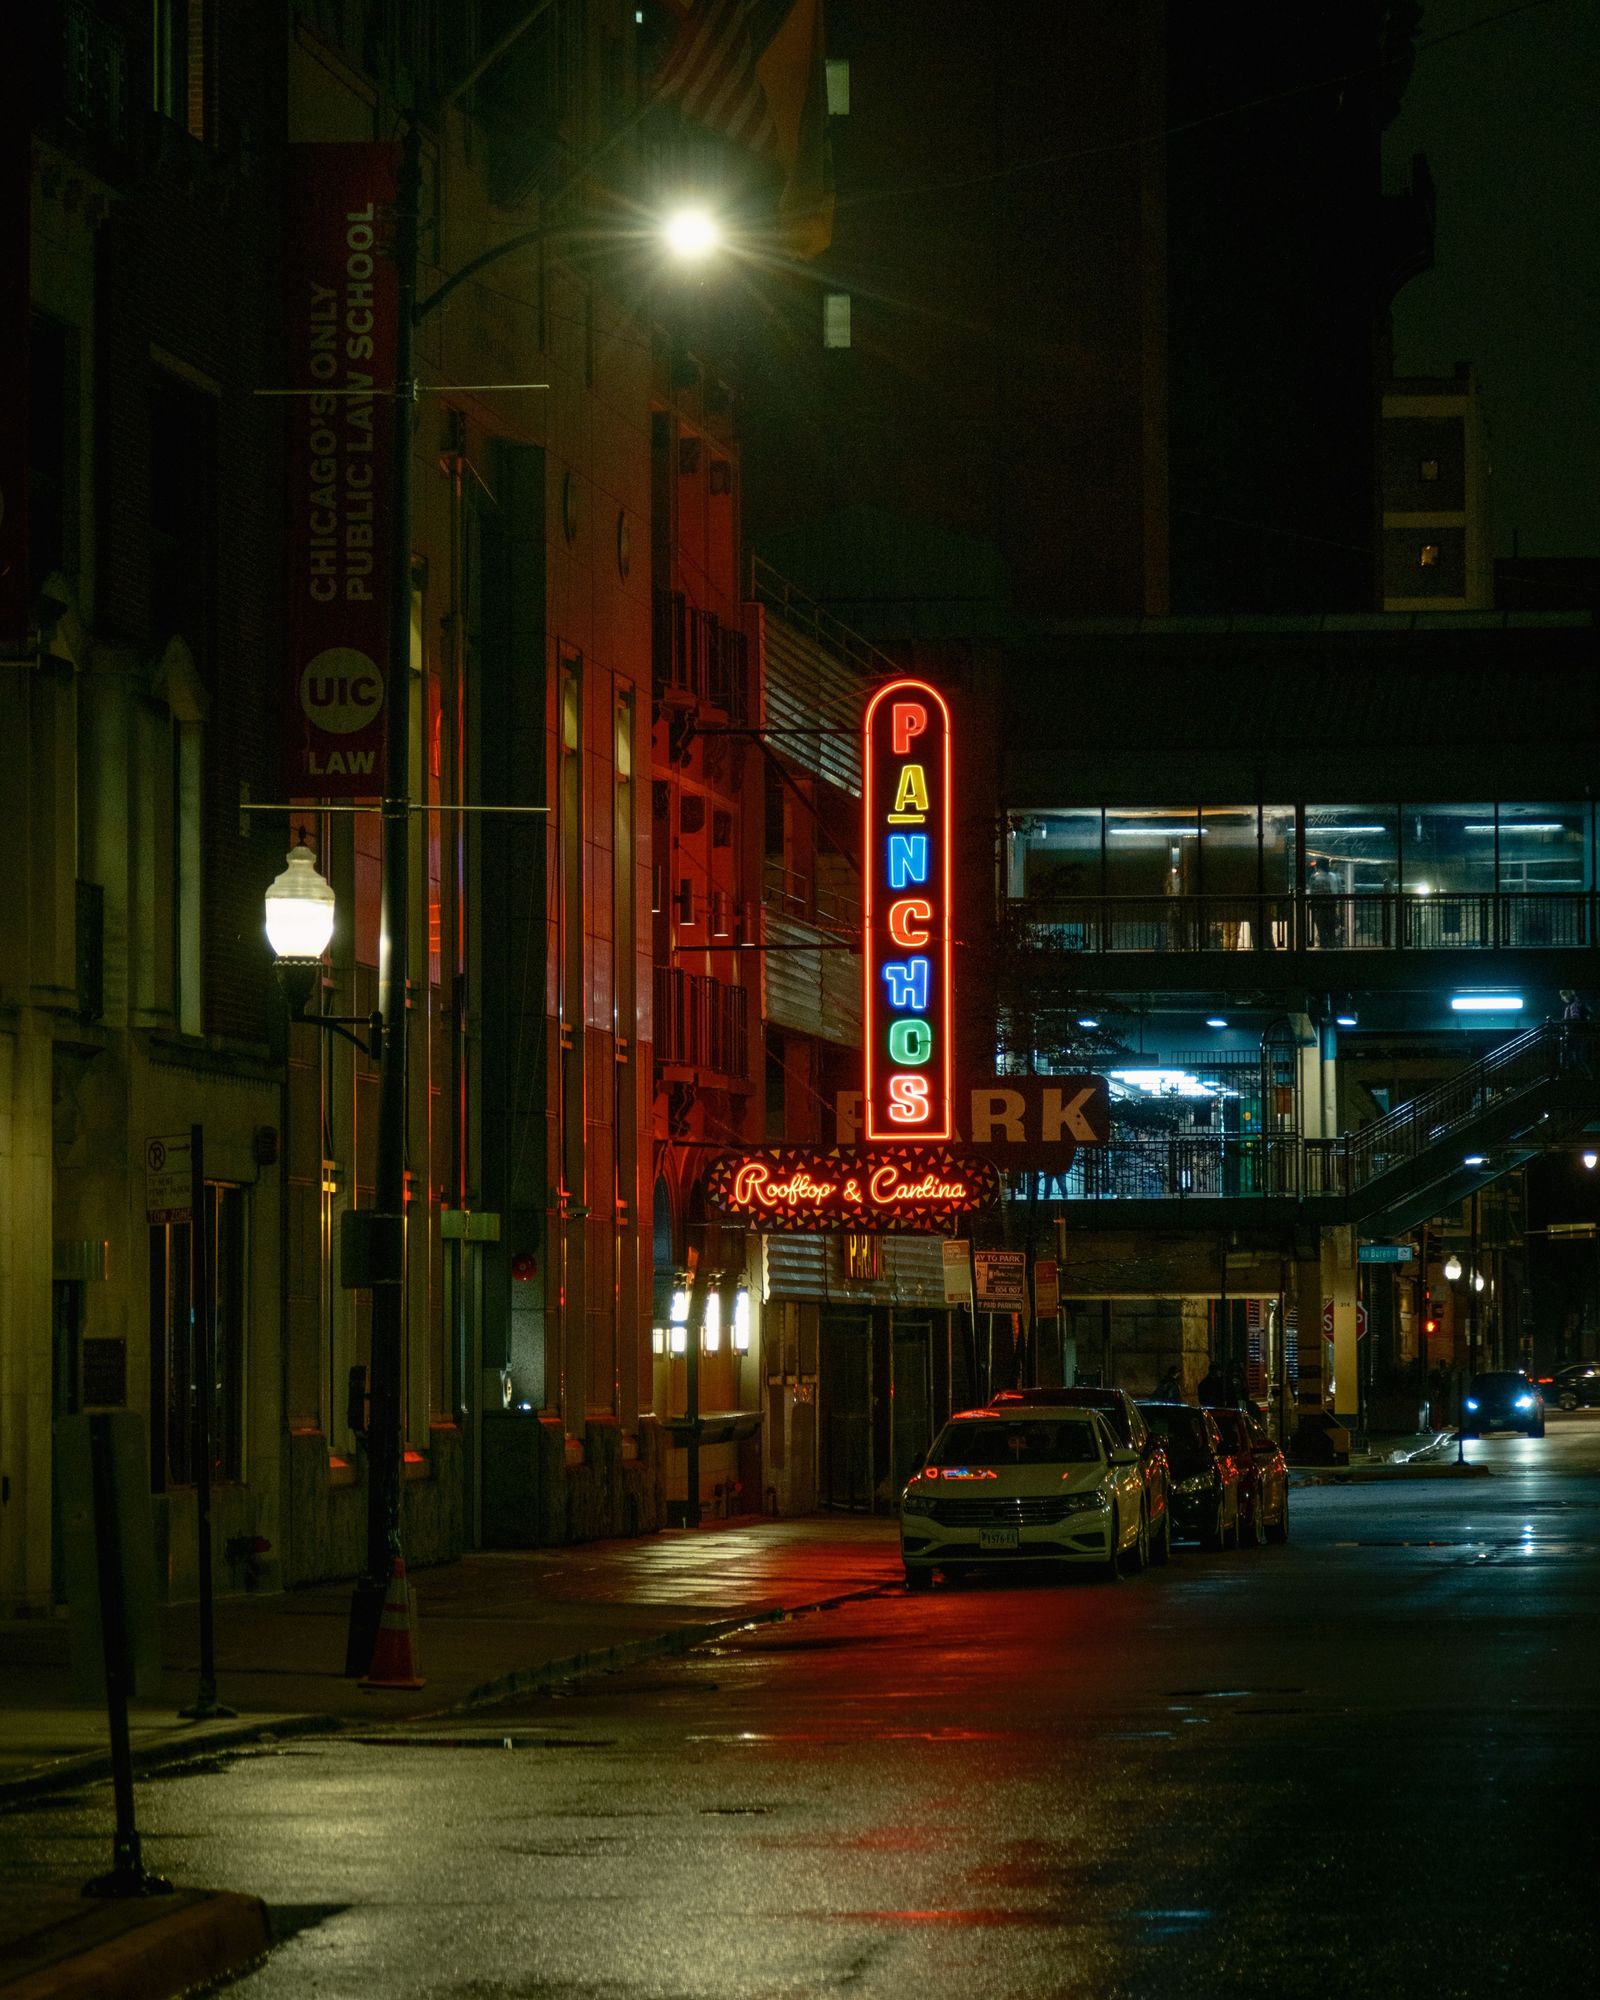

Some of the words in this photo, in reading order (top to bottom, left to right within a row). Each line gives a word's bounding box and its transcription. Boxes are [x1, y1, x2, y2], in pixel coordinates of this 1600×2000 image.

[346, 201, 375, 361] SCHOOL
[310, 281, 337, 380] ONLY
[346, 371, 374, 453] LAW
[310, 393, 337, 603] CHICAGO'S
[346, 463, 375, 601] PUBLIC
[308, 677, 376, 707] UIC
[308, 751, 376, 775] LAW
[885, 703, 931, 1122] PANCHOS
[735, 1164, 835, 1205] Rooftop
[843, 1180, 863, 1203] &
[871, 1166, 967, 1204] Cantina
[987, 1254, 998, 1262] TO
